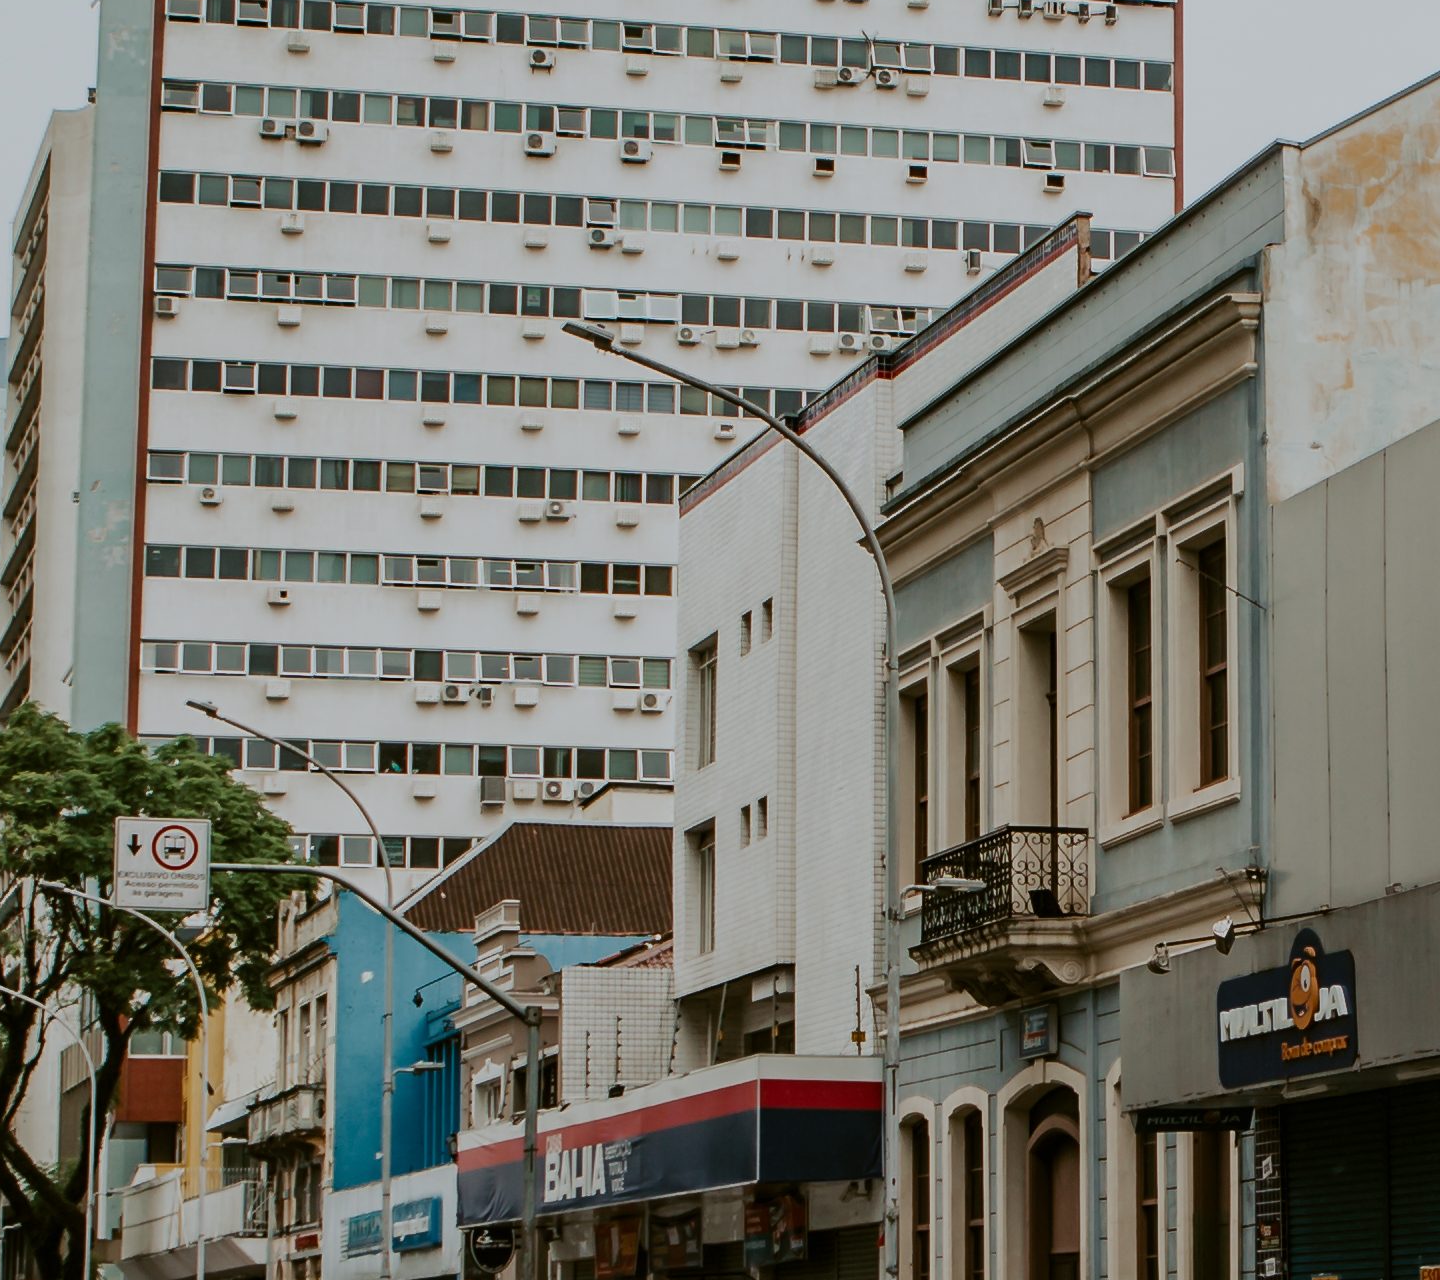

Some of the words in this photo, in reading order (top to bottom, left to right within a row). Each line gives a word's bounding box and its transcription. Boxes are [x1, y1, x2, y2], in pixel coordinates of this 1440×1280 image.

[118, 871, 169, 880] EXCLUSIVO
[170, 870, 206, 881] ÔNIBUS
[124, 880, 156, 888] Acesso
[158, 881, 199, 889] permitido
[144, 890, 184, 898] garagens
[1281, 1042, 1300, 1061] Bom
[1301, 1037, 1313, 1057] de
[1313, 1035, 1349, 1058] compras
[544, 1143, 606, 1203] BAHIA
